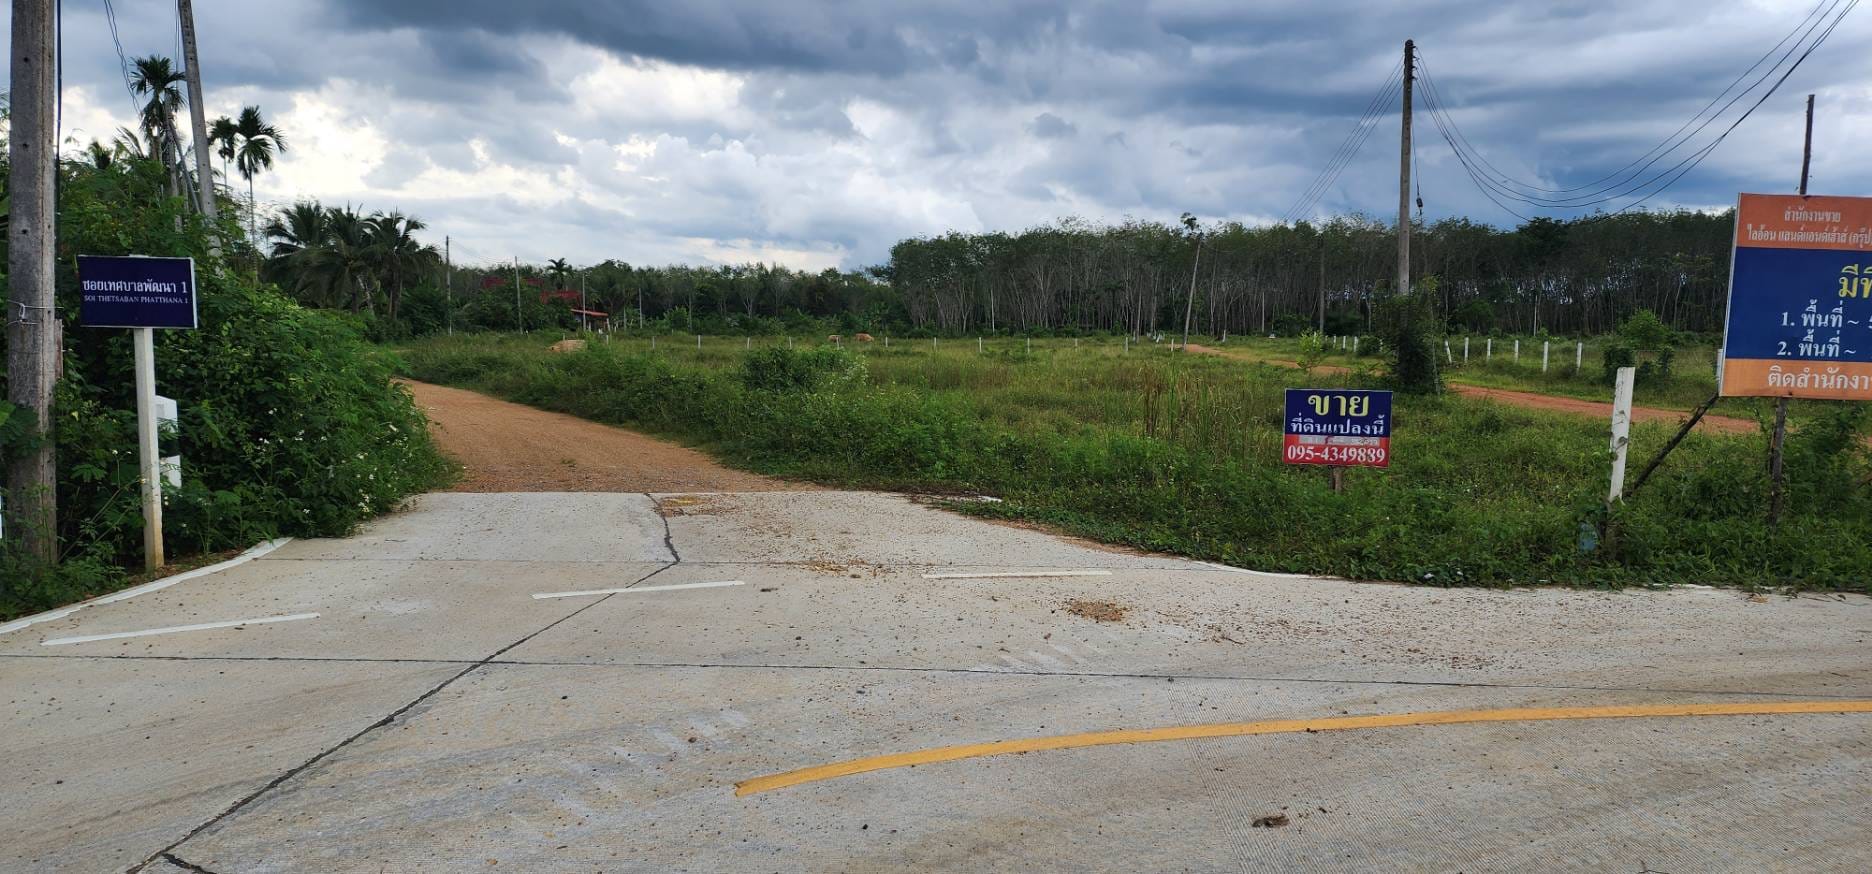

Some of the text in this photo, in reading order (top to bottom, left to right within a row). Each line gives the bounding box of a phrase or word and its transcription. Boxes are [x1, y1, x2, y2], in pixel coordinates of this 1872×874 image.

[1784, 205, 1841, 222] สำนักงานขาย
[83, 279, 188, 293] ซอยเทศบาลพัฒนา 1
[98, 295, 140, 303] THETSABAN
[141, 296, 183, 304] PHATTHANA
[1781, 312, 1795, 327] 1.
[1801, 299, 1843, 328] พื้นที่
[1777, 341, 1792, 356] 2.
[1798, 329, 1841, 358] พื้นที่
[1768, 365, 1872, 389] ติดสำนักงา
[1308, 395, 1369, 417] ขาย
[1291, 413, 1385, 435] ที่ดินแปลงนี้
[1287, 445, 1386, 462] 095-4349889
